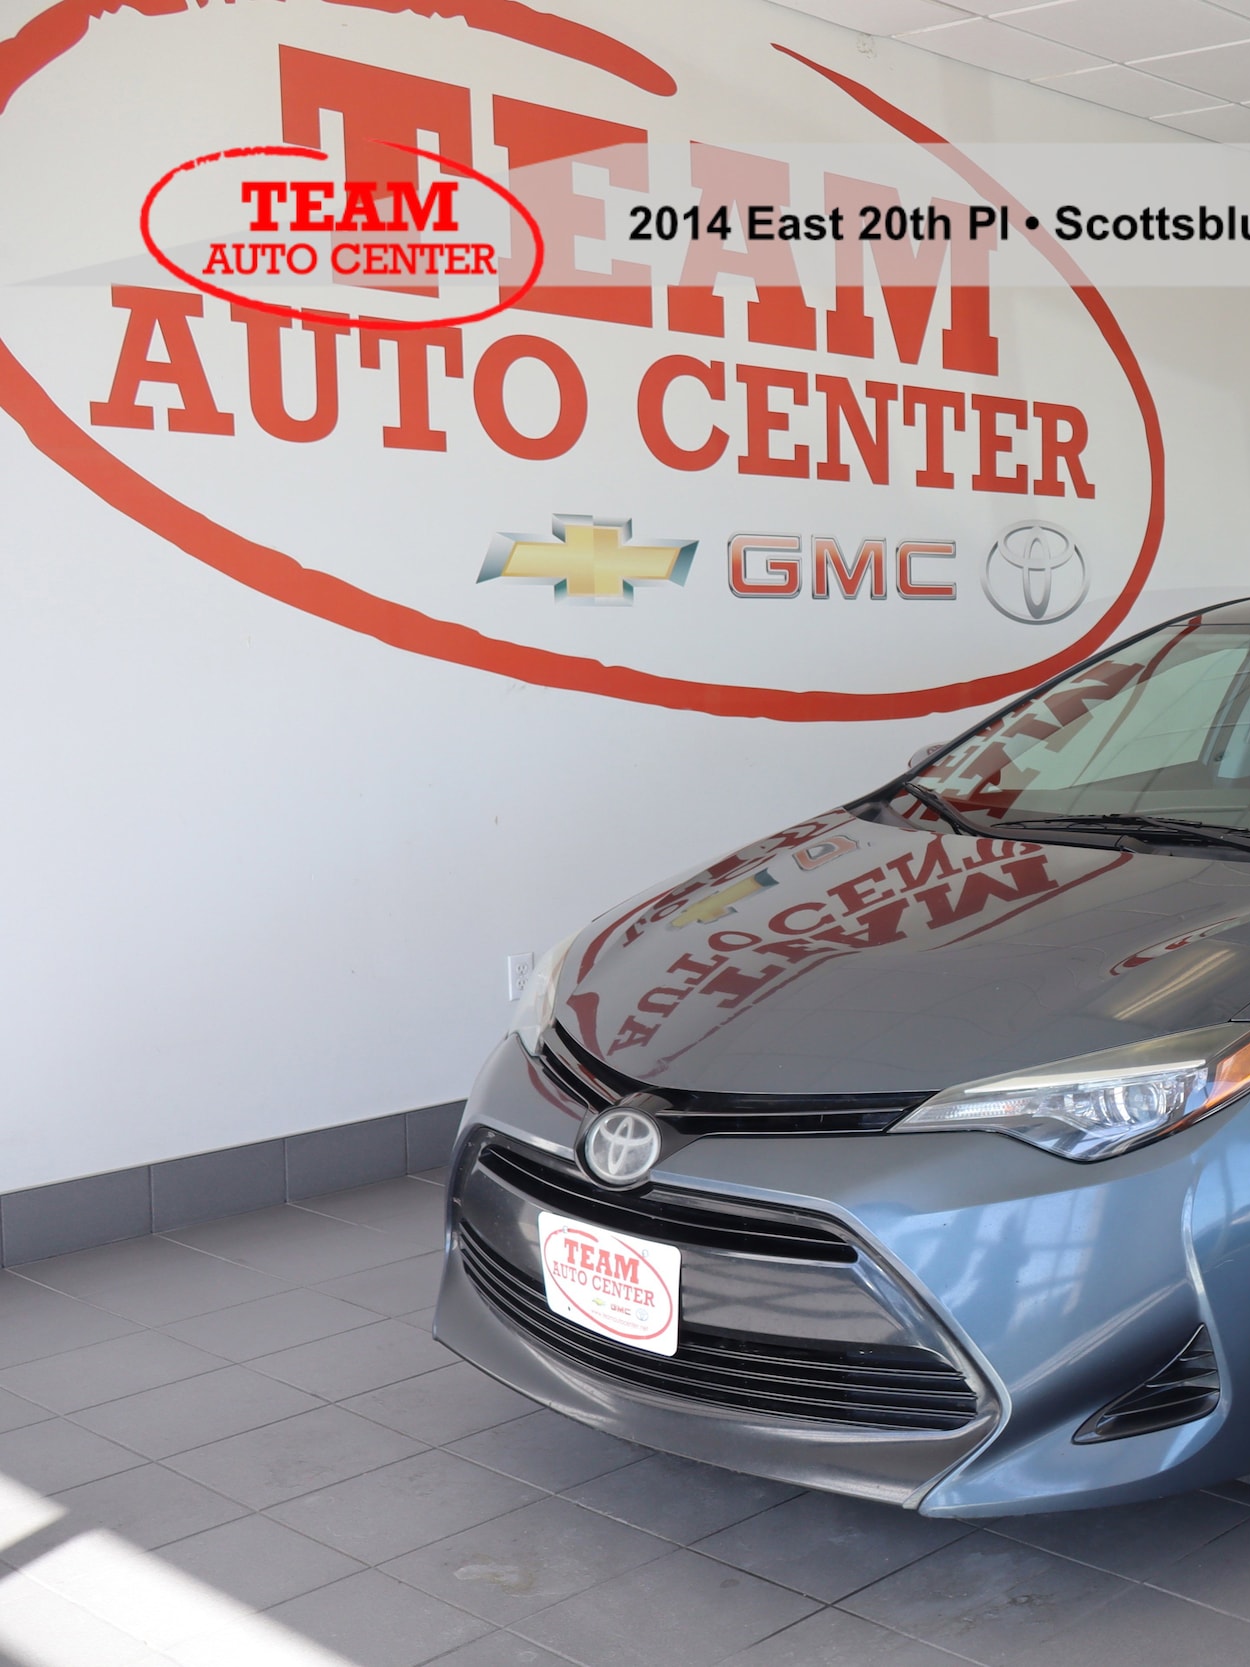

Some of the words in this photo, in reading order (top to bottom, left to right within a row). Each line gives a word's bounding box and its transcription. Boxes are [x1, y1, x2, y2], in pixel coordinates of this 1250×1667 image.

[279, 44, 998, 376] TEAM
[90, 284, 588, 460] AUTO
[637, 355, 1095, 500] CENTER
[728, 532, 957, 601] GMC
[553, 1261, 588, 1287] AUTO
[592, 1274, 656, 1308] CENTER
[564, 1238, 639, 1284] TEAM
[611, 1304, 631, 1316] GMC
